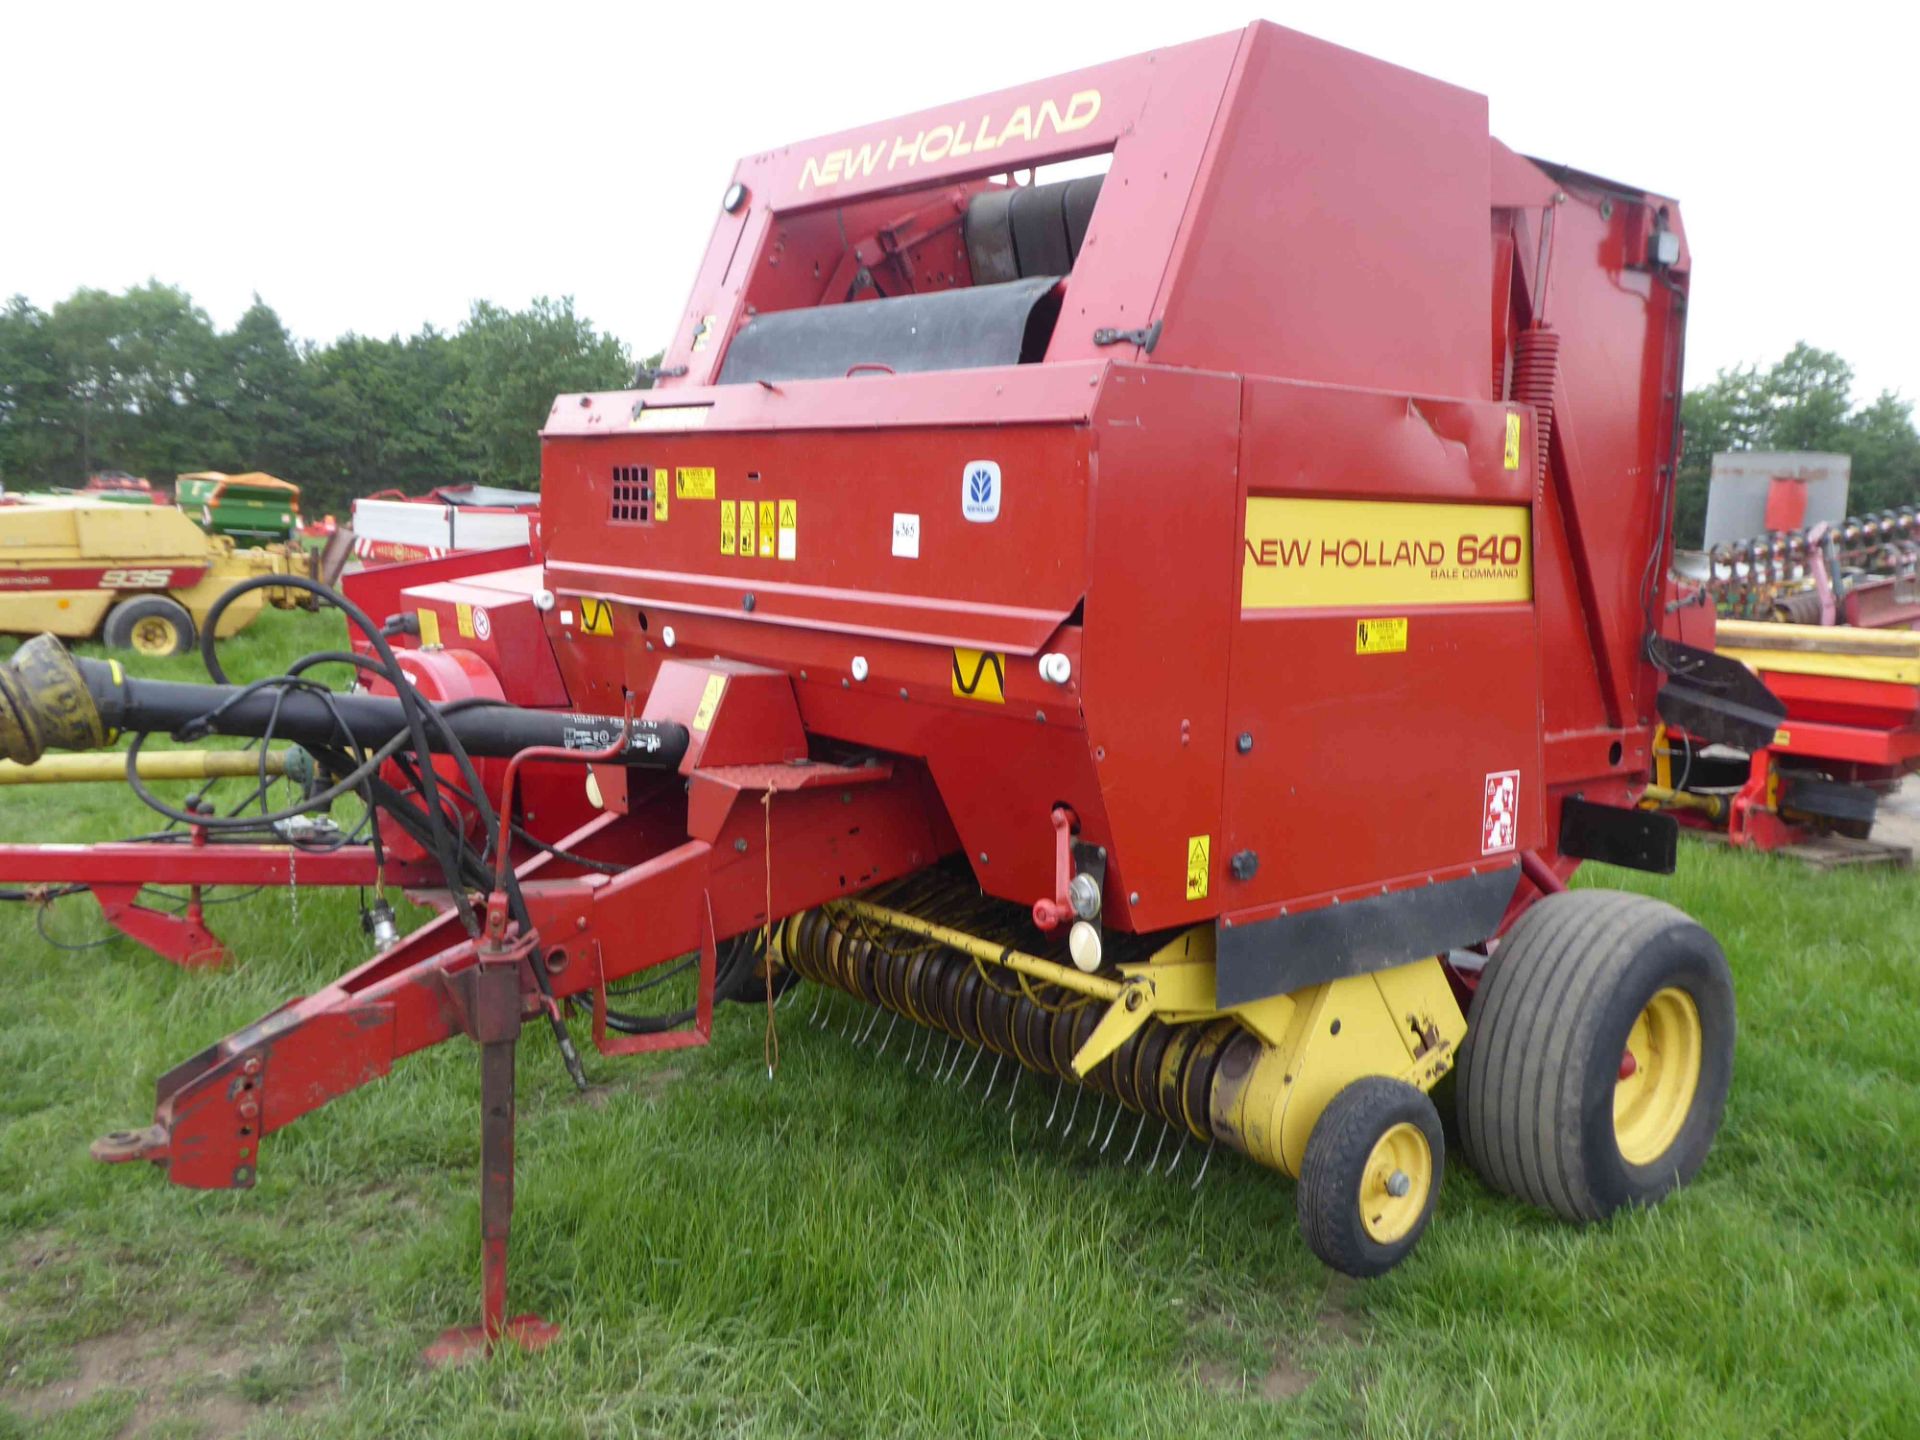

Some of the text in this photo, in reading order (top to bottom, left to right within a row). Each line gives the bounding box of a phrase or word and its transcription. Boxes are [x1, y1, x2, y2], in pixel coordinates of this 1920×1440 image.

[798, 89, 1102, 191] NEW HOLLAND
[1244, 534, 1522, 568] NEW HOLLAND 640
[1430, 567, 1519, 580] BALE COMMAND
